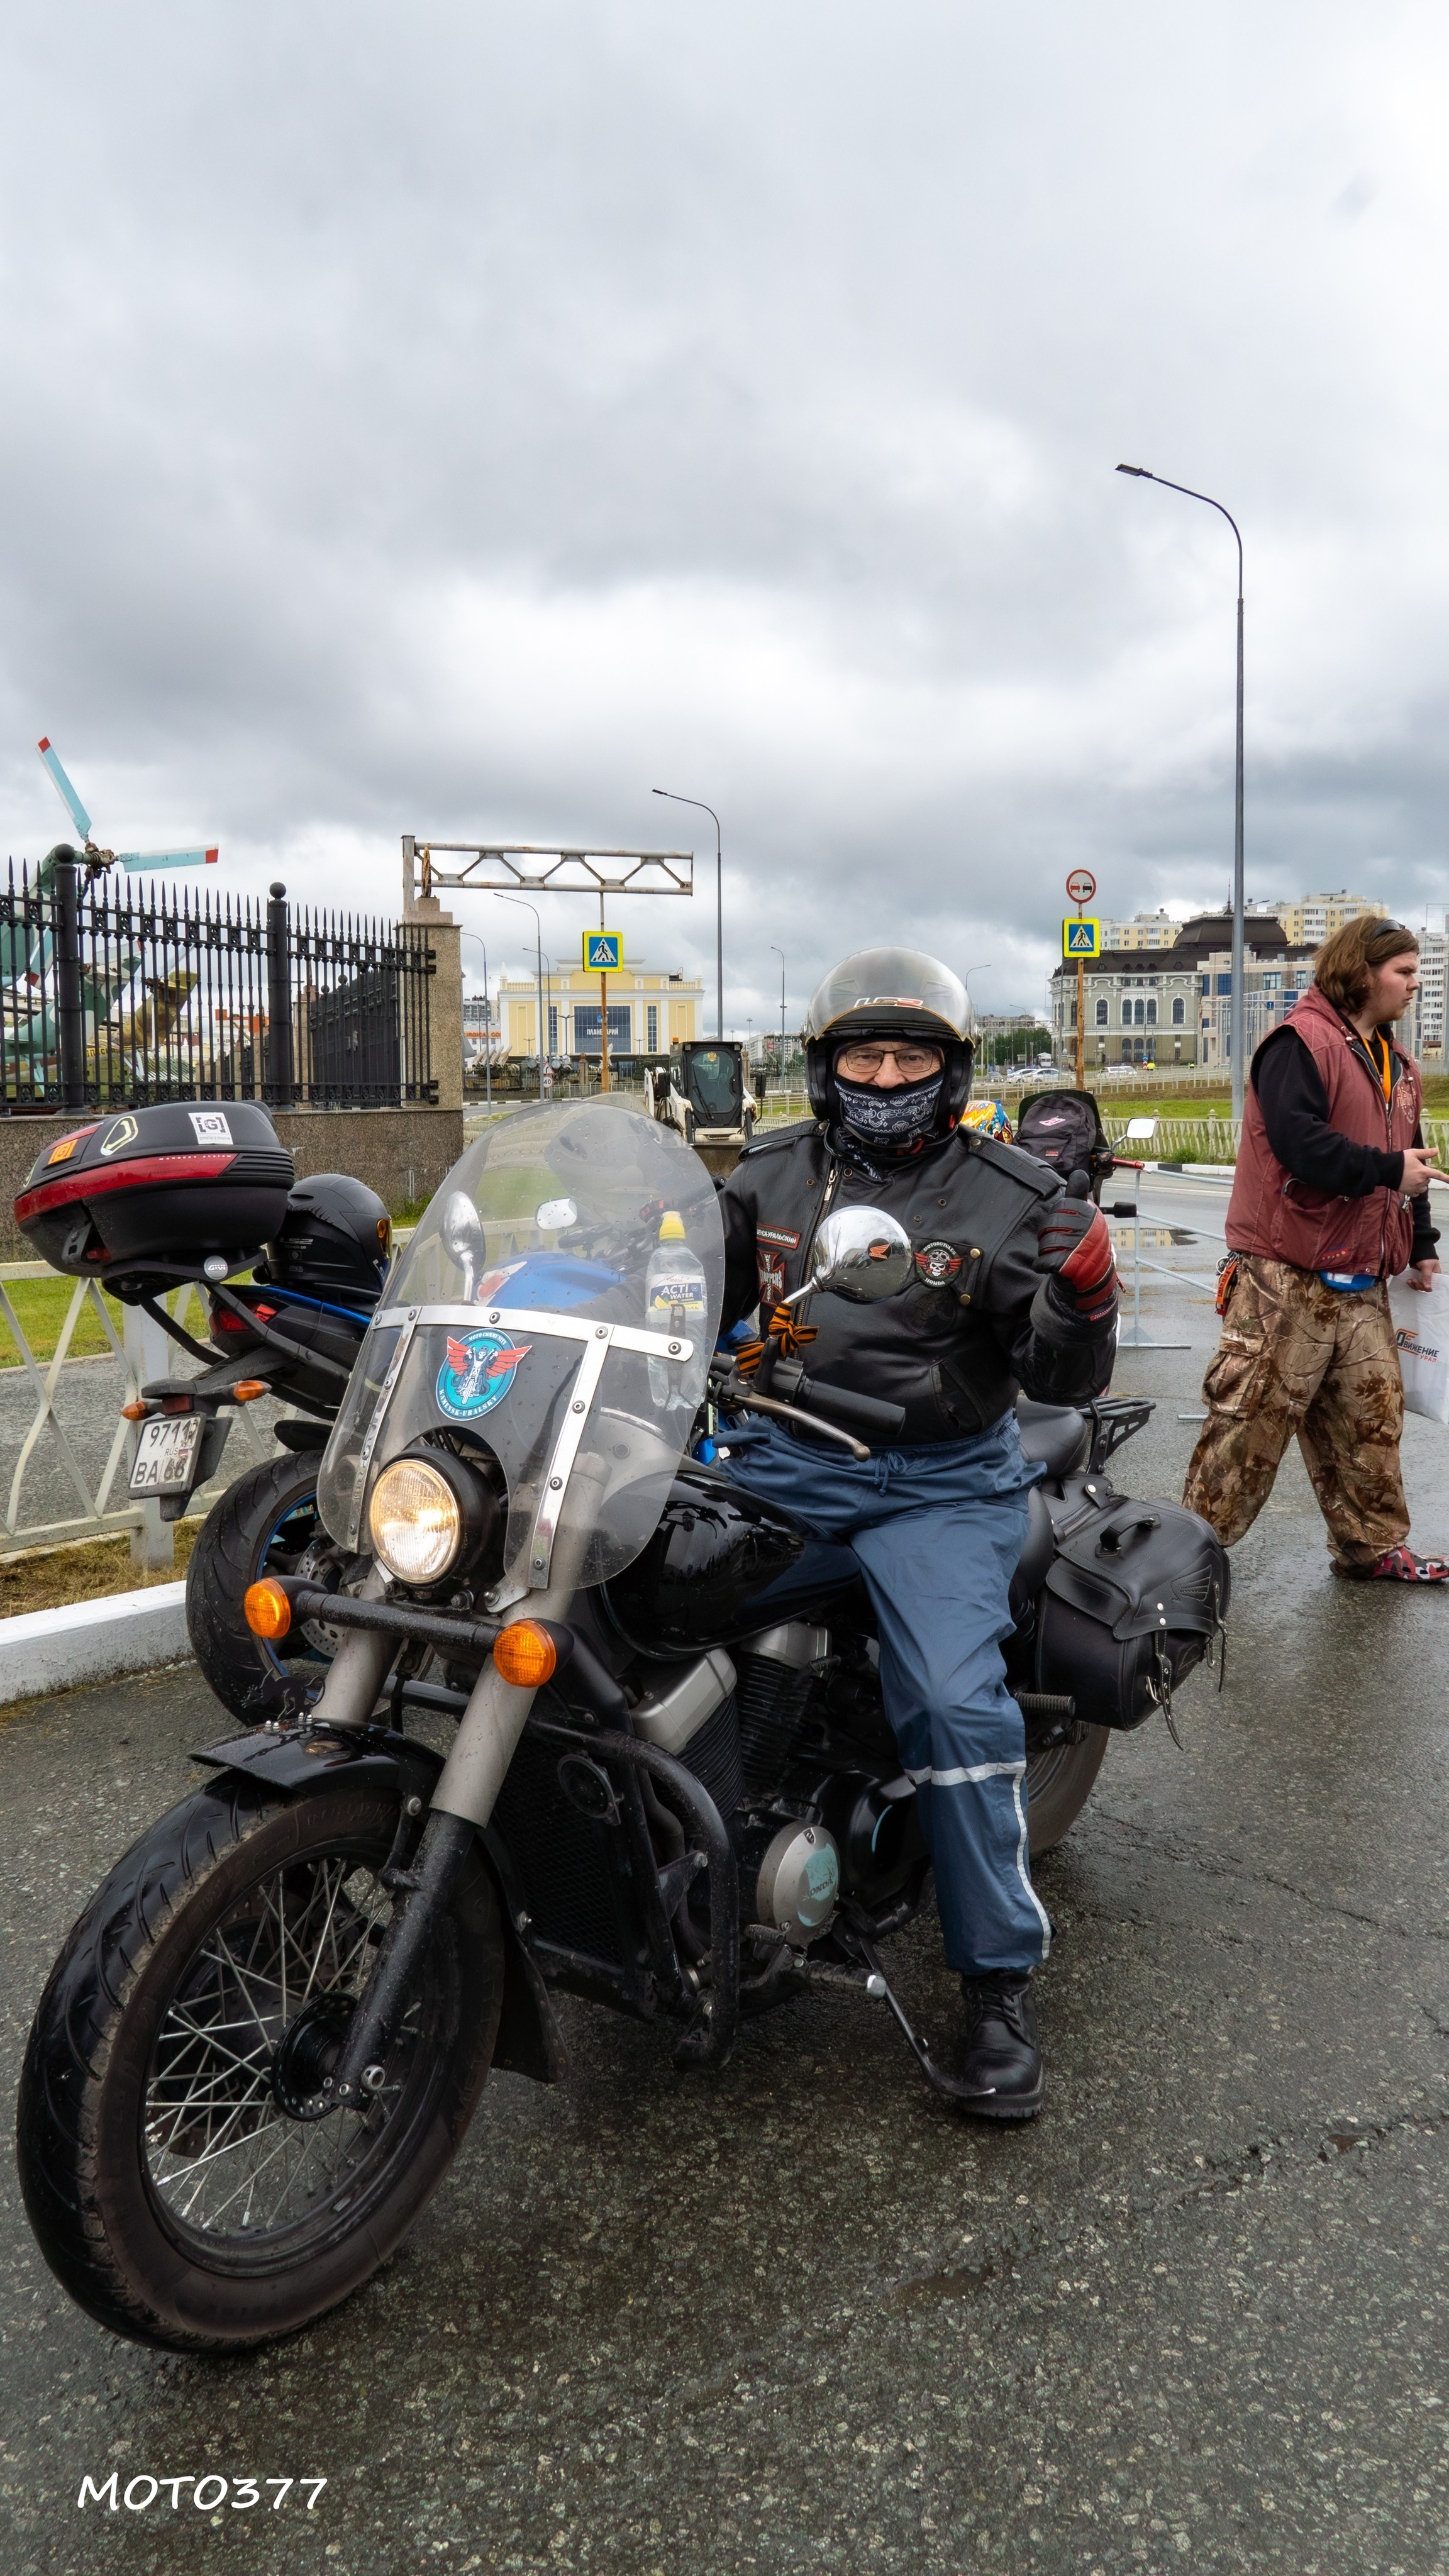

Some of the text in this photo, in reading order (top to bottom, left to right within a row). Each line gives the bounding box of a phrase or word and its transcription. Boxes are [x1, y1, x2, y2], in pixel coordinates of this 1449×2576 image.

[924, 1277, 946, 1286] HONDA
[469, 1333, 482, 1341] MOTO
[1419, 1354, 1437, 1363] УРАЛ
[164, 1447, 179, 1457] RUS
